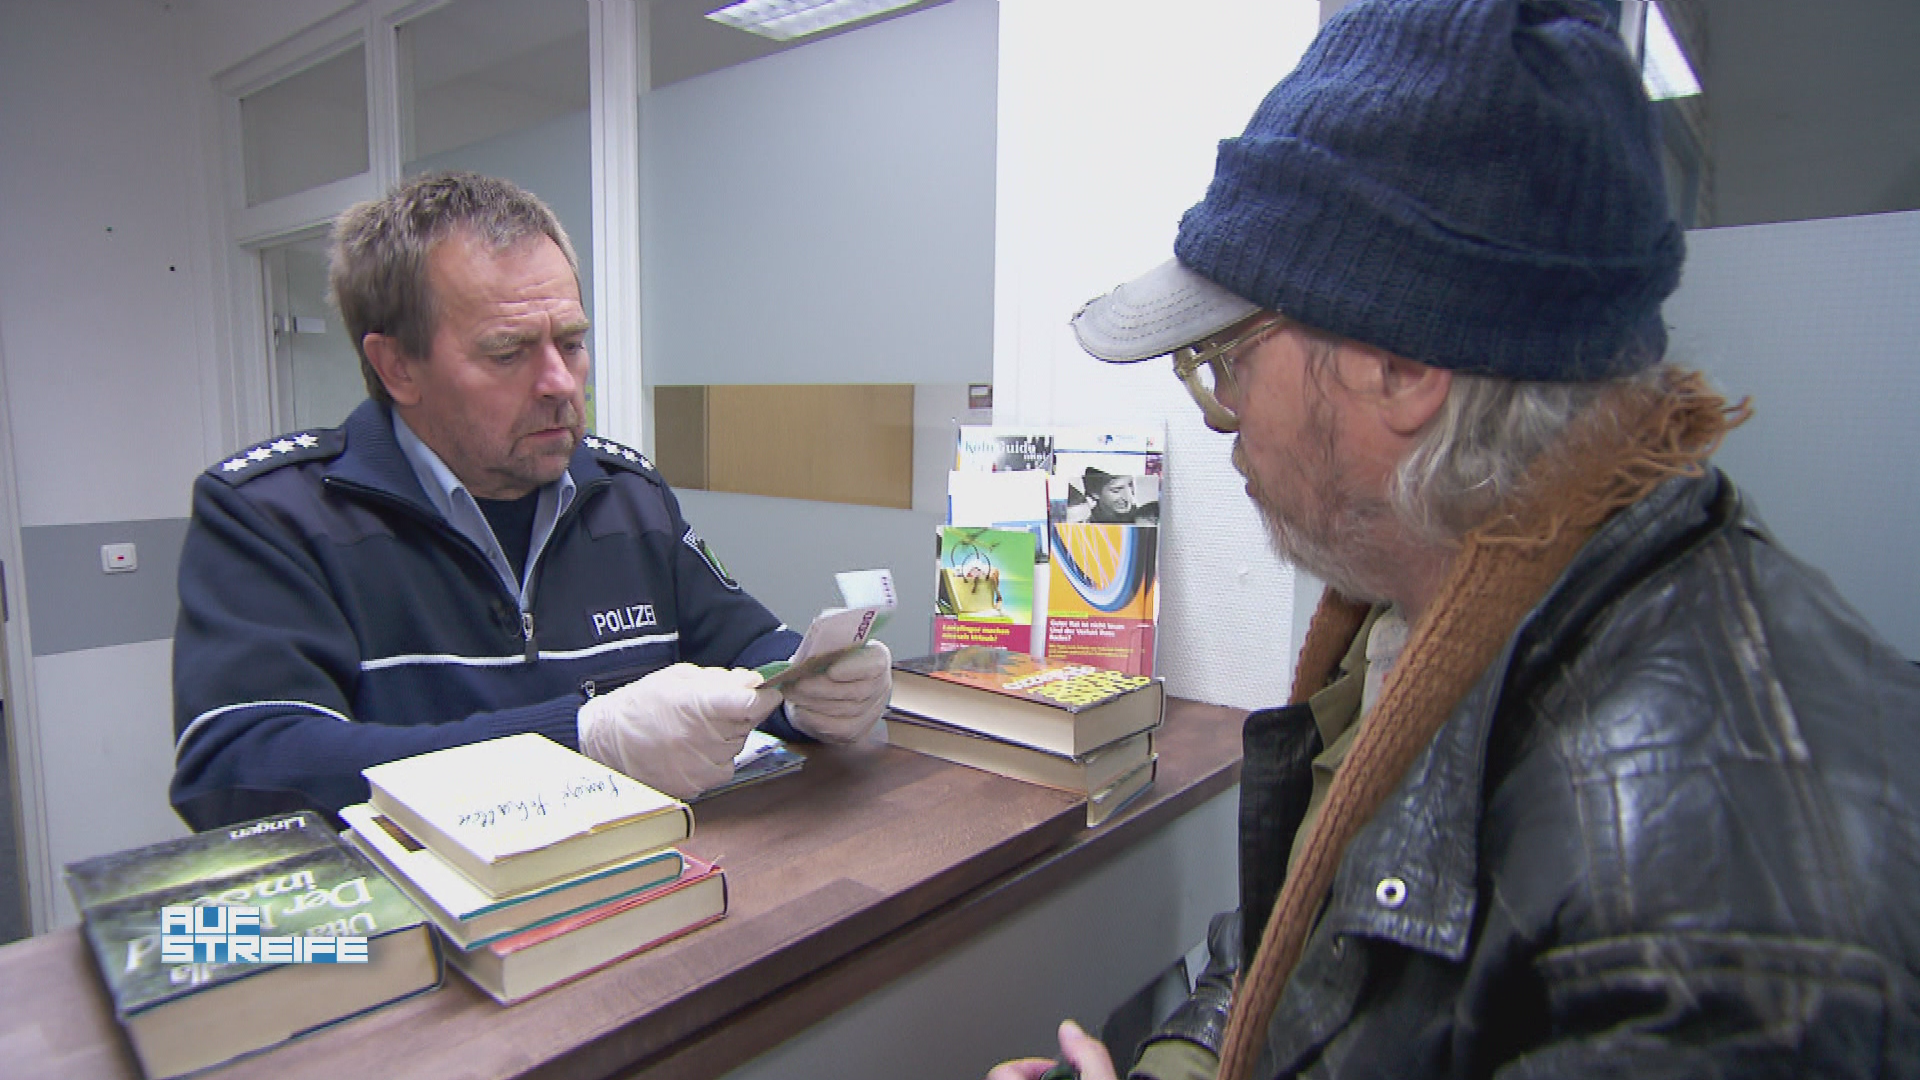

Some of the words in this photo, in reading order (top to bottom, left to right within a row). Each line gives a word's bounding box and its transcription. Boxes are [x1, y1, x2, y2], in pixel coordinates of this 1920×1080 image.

[228, 815, 307, 840] Lingen
[254, 869, 317, 897] im
[281, 877, 373, 916] Der
